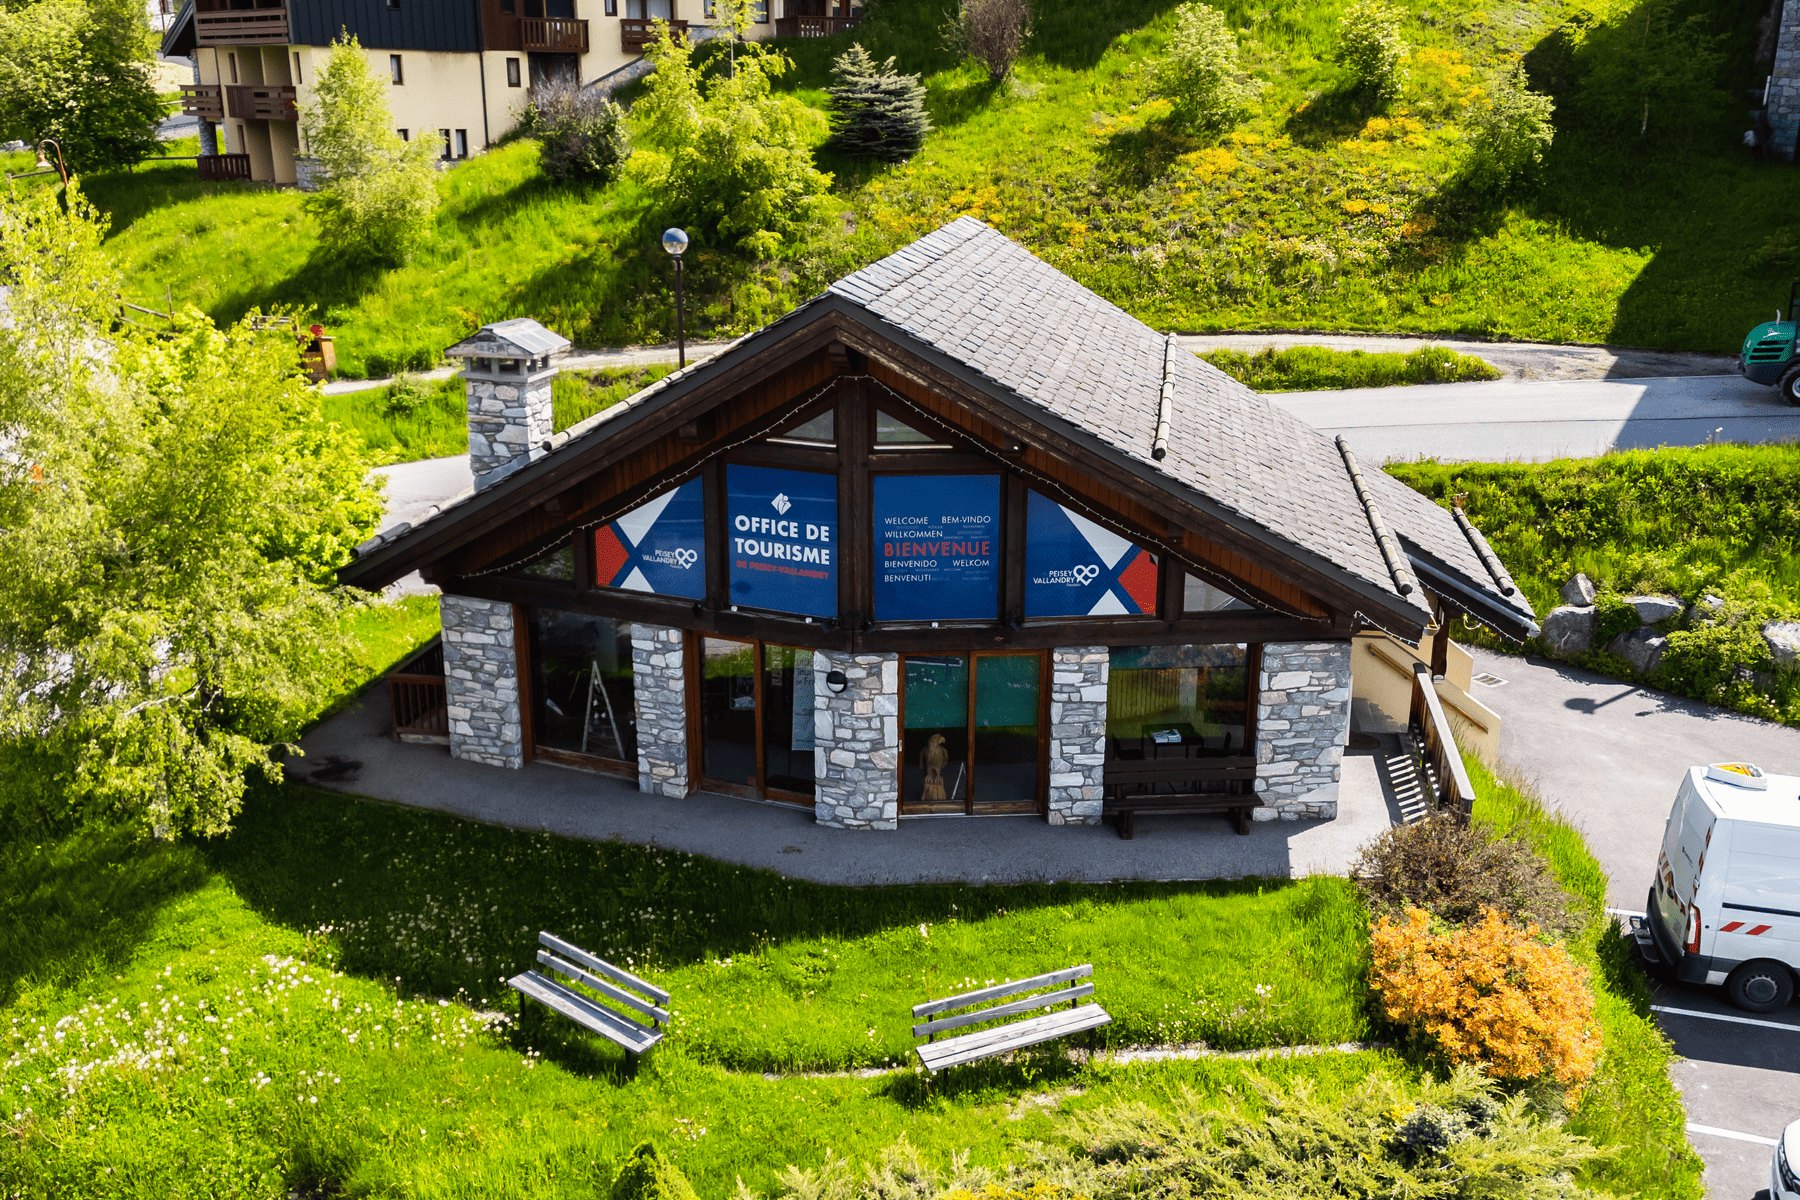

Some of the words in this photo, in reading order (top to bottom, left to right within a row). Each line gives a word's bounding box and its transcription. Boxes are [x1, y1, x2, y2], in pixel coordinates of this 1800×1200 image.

[884, 516, 929, 525] WELCOME
[941, 515, 992, 524] BEM-VINDO
[734, 514, 799, 538] OFFICE
[806, 523, 830, 542] DE
[884, 530, 943, 539] WILLKOMMEN
[654, 549, 676, 558] PEISEY
[734, 537, 830, 565] TOURISME
[884, 541, 990, 557] BIENVENUE
[641, 554, 678, 565] VALLANDRY
[884, 559, 938, 568] BIENVENIDO
[952, 558, 990, 567] WELKOM
[884, 574, 931, 583] BENVENUTI
[1048, 570, 1073, 578] PEISEY
[1033, 576, 1075, 584] VALLANDRY
